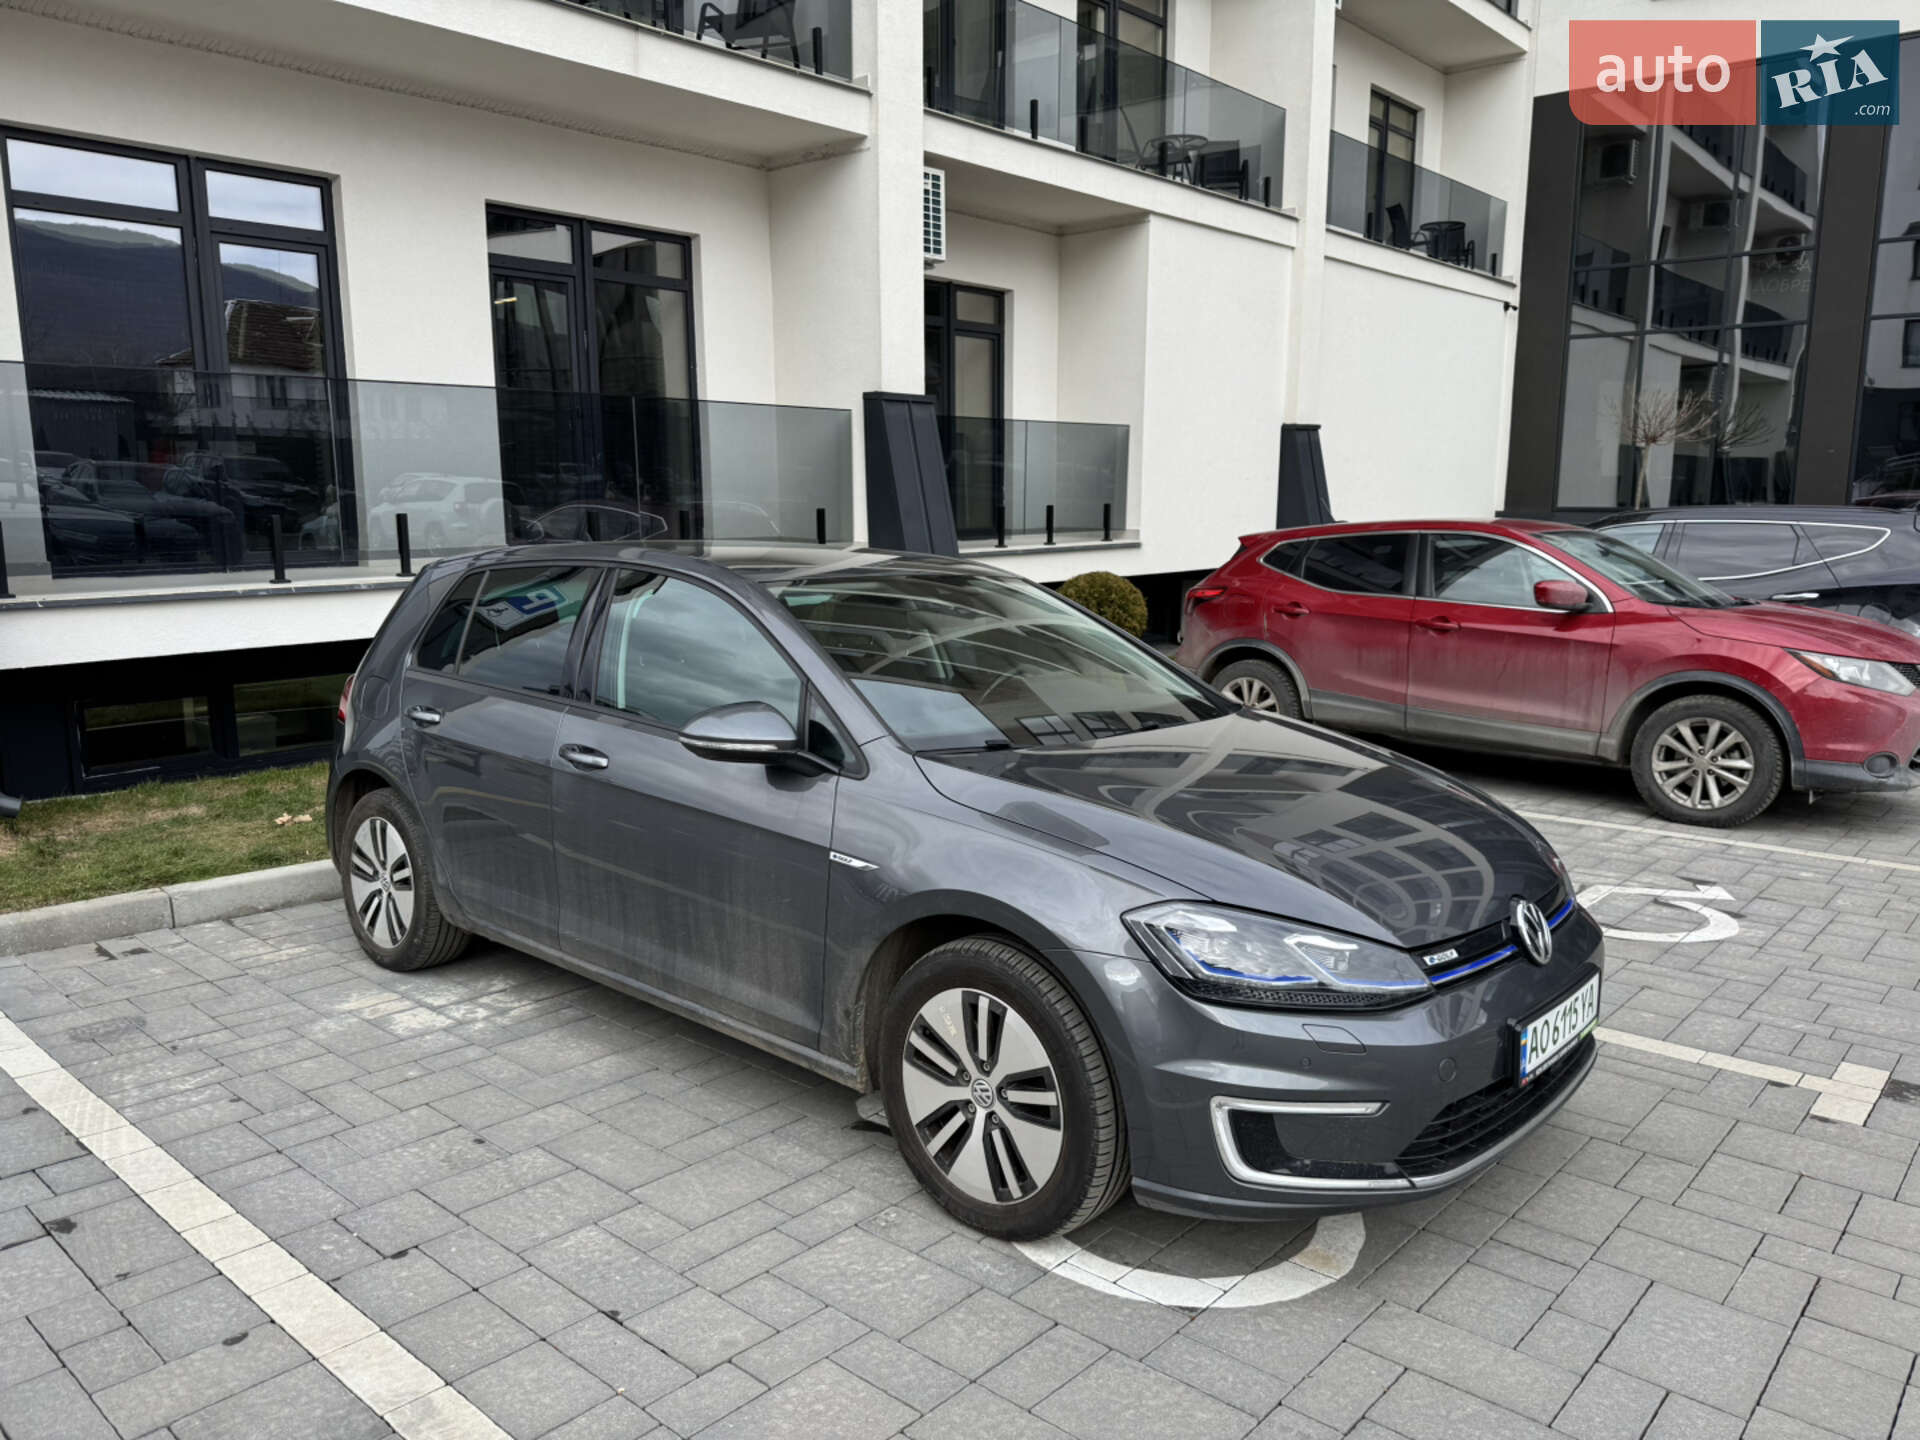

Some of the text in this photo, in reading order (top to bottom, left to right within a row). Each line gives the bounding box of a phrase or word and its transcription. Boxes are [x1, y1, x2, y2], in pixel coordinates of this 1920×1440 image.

[1528, 1019, 1551, 1065] AO
[1552, 995, 1580, 1046] 6115
[1581, 983, 1595, 1024] YA
